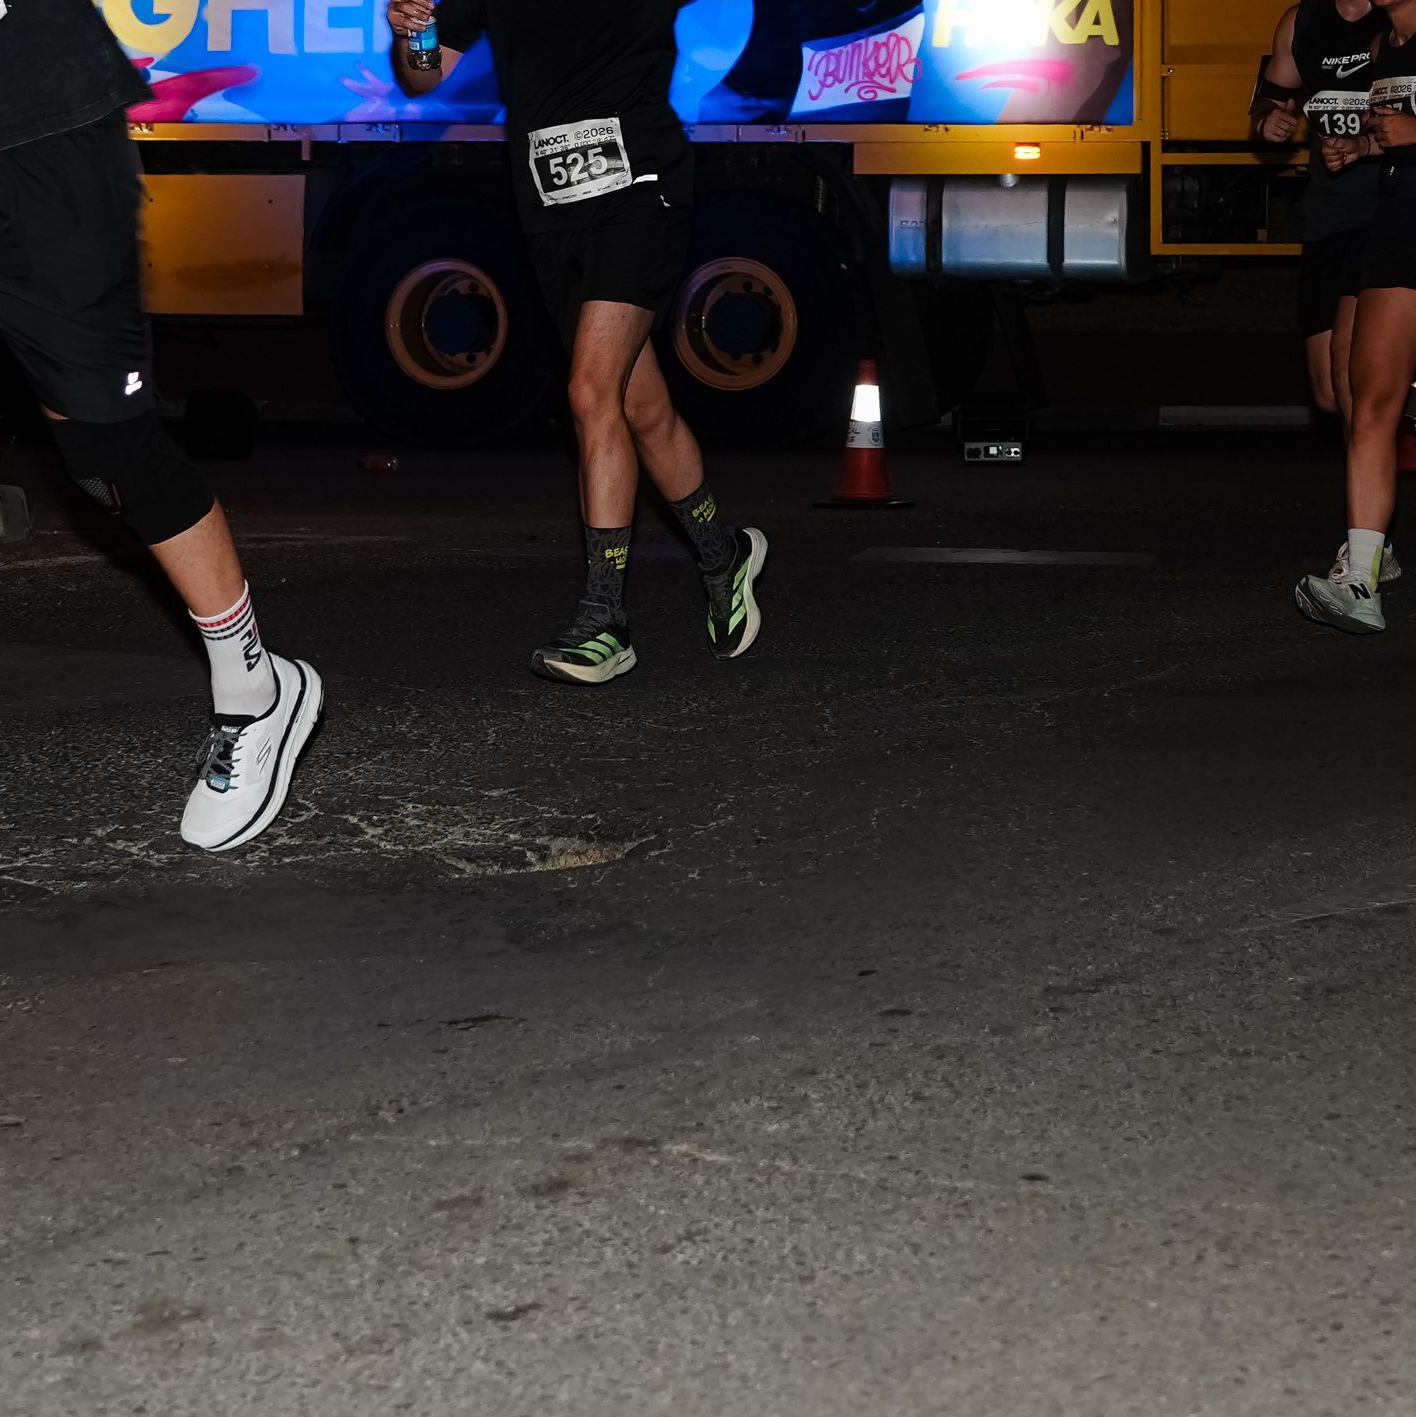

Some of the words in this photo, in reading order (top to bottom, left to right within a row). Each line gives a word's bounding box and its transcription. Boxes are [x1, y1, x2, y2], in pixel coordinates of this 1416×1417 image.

[1322, 55, 1351, 64] NIKE
[1309, 97, 1338, 105] LANOCT.
[1320, 113, 1361, 135] 139
[533, 134, 569, 150] LANOCT.
[574, 126, 614, 141] ©2026
[549, 147, 608, 185] 525
